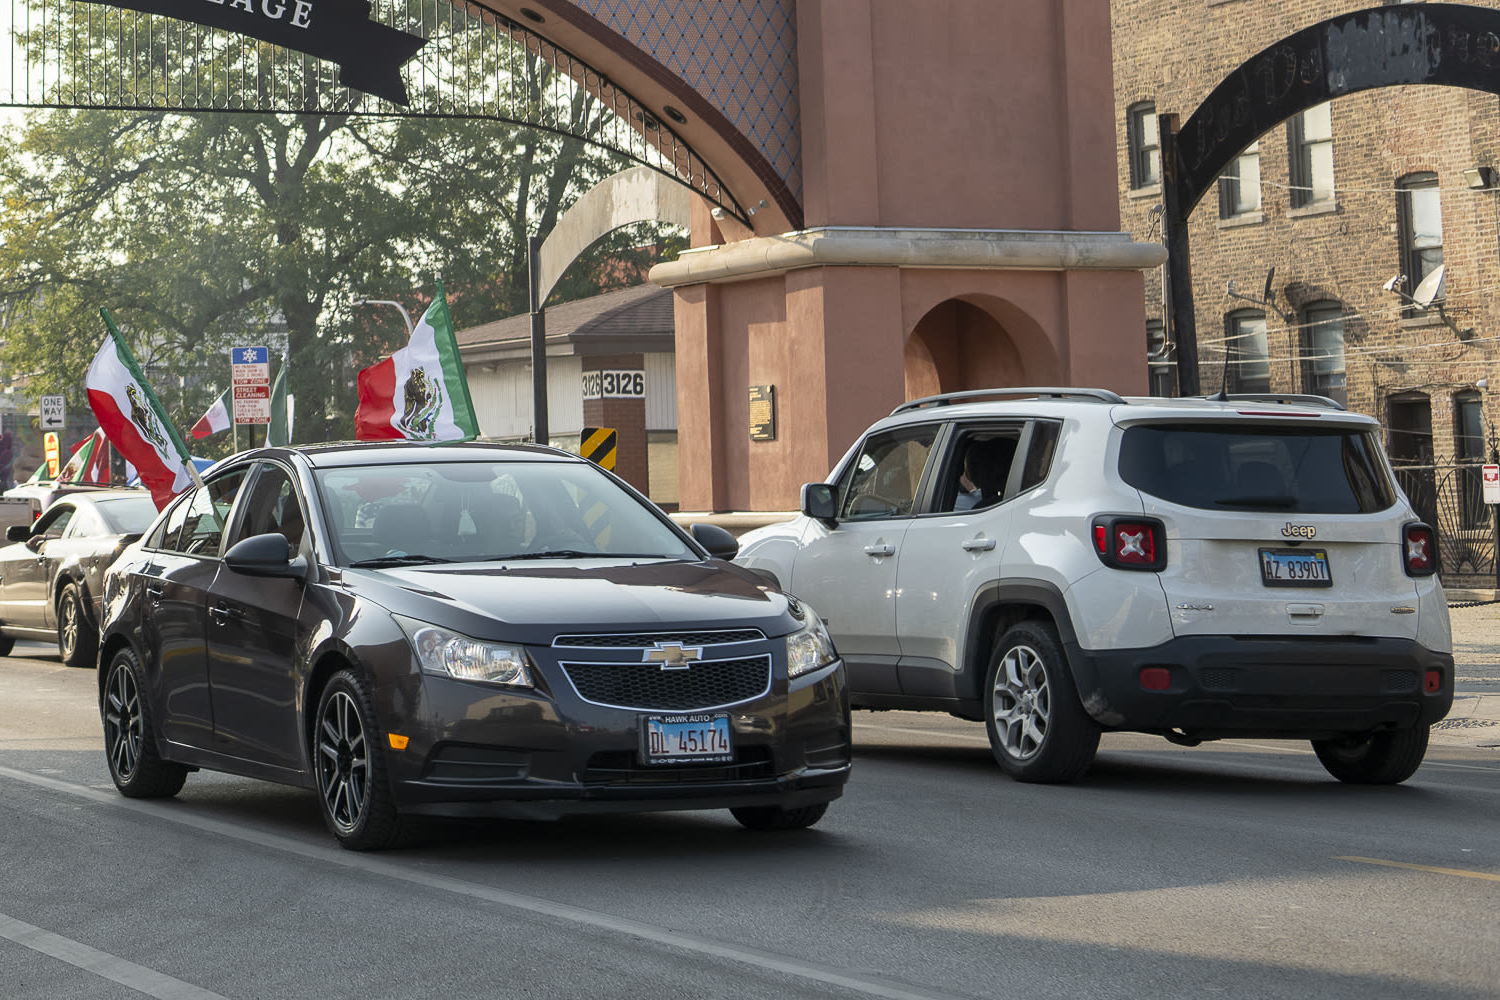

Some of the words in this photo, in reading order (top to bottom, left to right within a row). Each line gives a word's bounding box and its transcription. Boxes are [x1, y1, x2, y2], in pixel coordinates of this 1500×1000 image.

[582, 373, 601, 396] 3126
[603, 373, 644, 395] 3126
[43, 398, 63, 406] ONE
[43, 407, 63, 415] WAY
[1282, 522, 1316, 539] Jeep
[1266, 560, 1281, 579] AZ
[1288, 560, 1325, 579] 83907
[651, 731, 670, 754] DL
[679, 729, 727, 752] 45174
